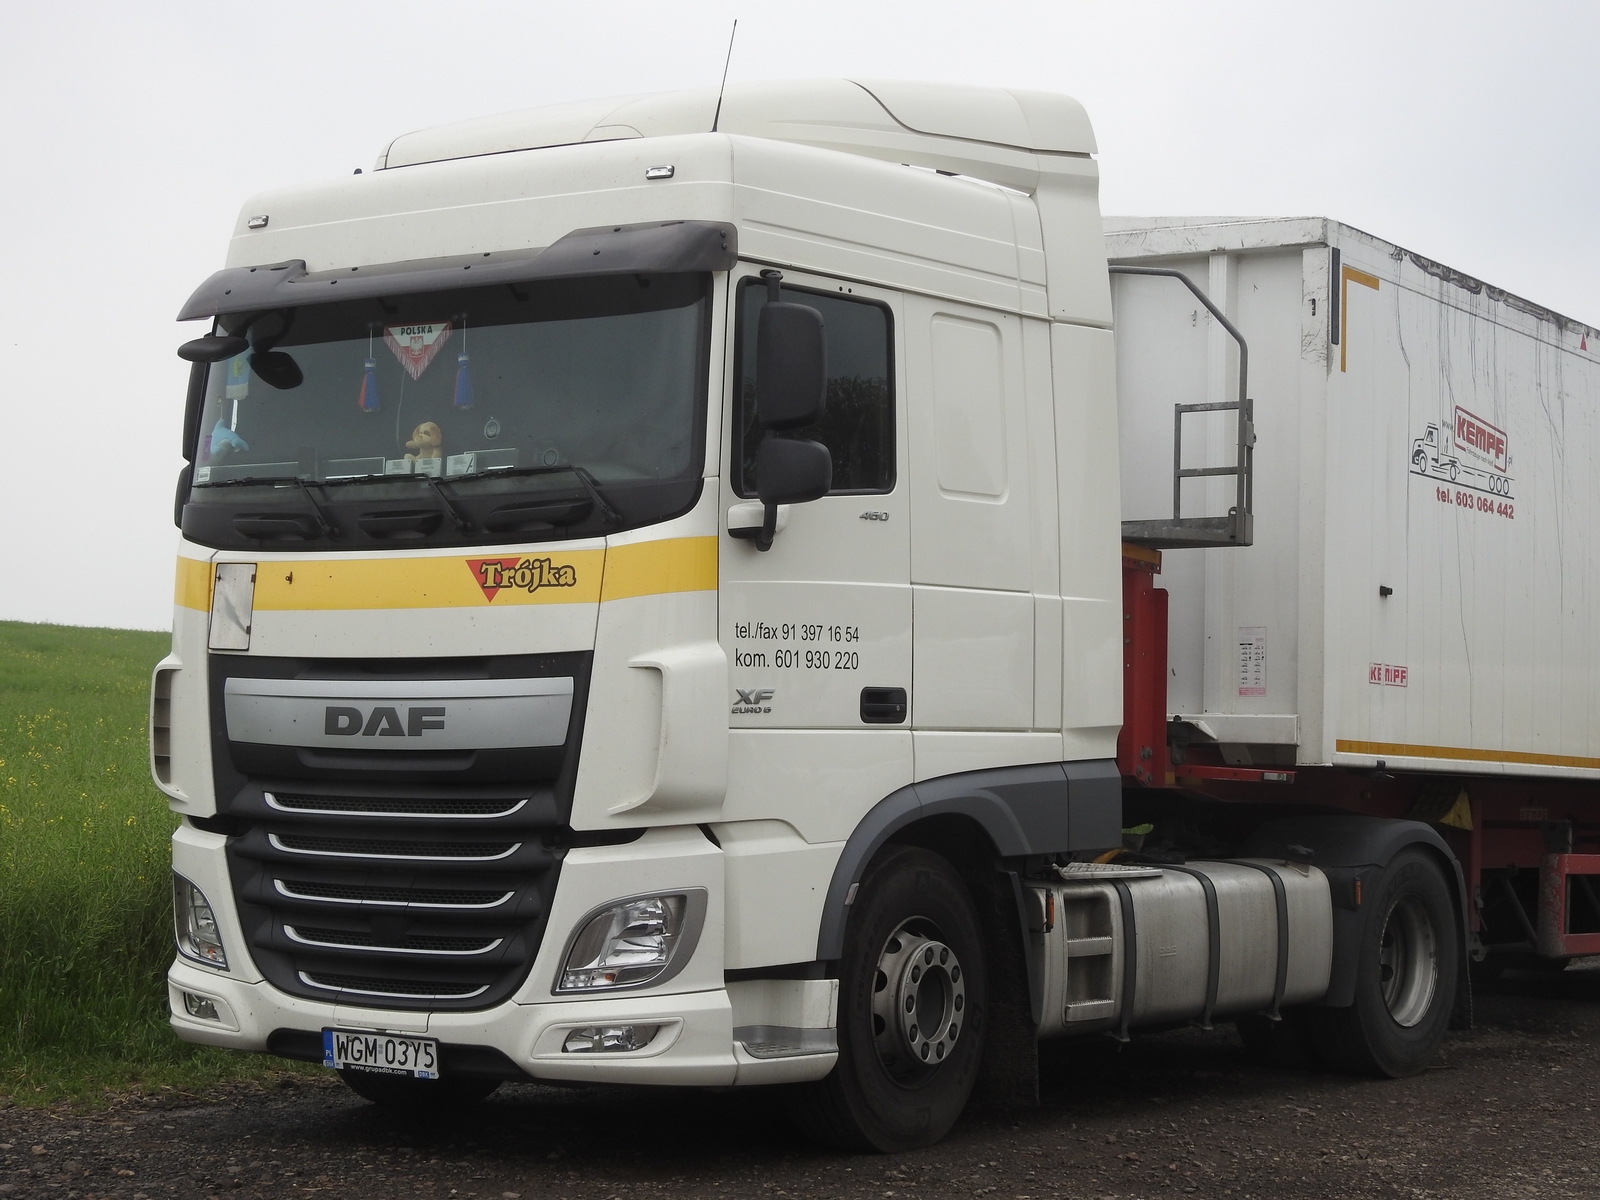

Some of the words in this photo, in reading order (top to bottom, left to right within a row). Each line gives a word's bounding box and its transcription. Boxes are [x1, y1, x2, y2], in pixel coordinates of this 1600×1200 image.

[400, 325, 433, 336] POLSKA
[1457, 414, 1505, 460] KEMPF
[1436, 486, 1453, 504] tel.
[1456, 491, 1474, 509] 603
[1477, 496, 1495, 514] 064
[1496, 502, 1515, 520] 442
[859, 511, 890, 521] 460
[480, 557, 577, 594] Trójka
[735, 622, 778, 640] tel./fax
[782, 623, 796, 640] 91
[801, 624, 823, 641] 397
[828, 625, 842, 642] 16
[845, 626, 860, 643] 54
[735, 648, 770, 668] kom.
[775, 649, 799, 668] 601
[805, 650, 830, 669] 930
[835, 651, 859, 670] 220
[1371, 666, 1407, 684] KEMPF
[732, 688, 776, 706] XF
[731, 706, 762, 714] EURO
[763, 706, 772, 714] 6
[325, 706, 446, 736] DAF
[325, 1049, 333, 1057] PL
[336, 1034, 378, 1064] WGM
[385, 1039, 435, 1069] 03Y5
[350, 1064, 408, 1075] www.grupadbk.com
